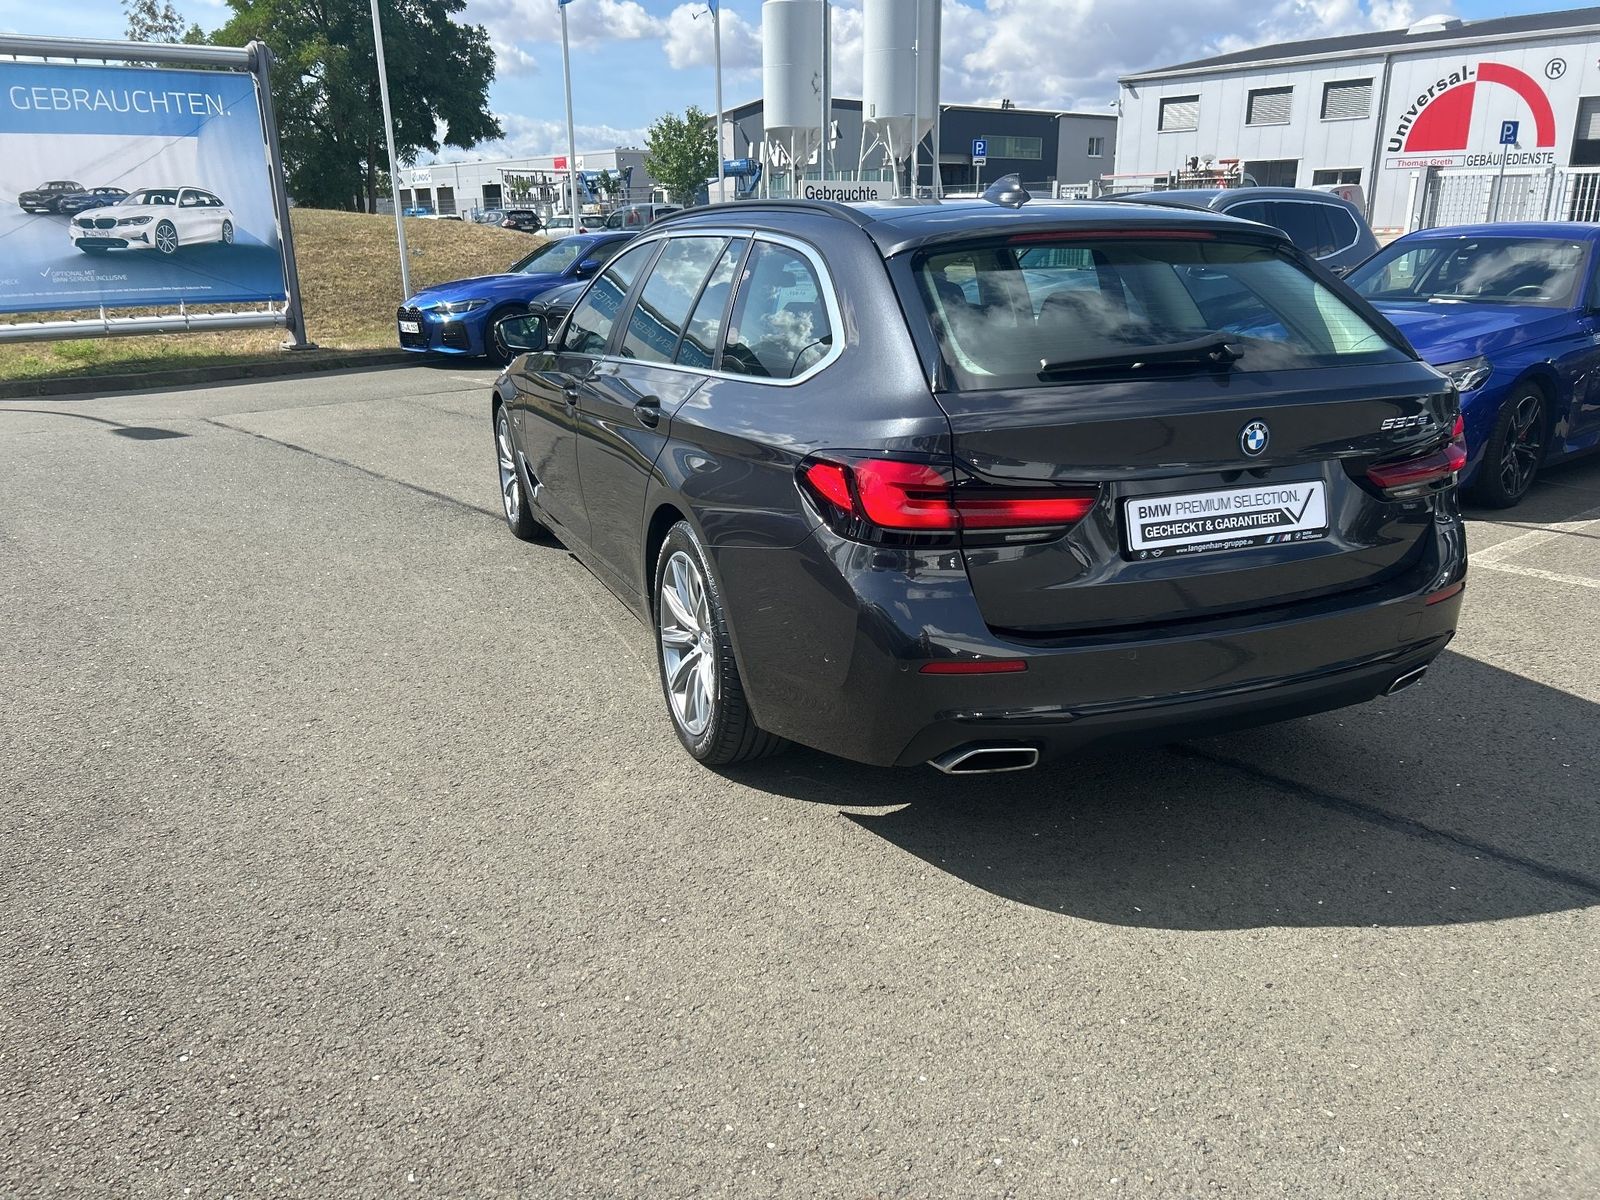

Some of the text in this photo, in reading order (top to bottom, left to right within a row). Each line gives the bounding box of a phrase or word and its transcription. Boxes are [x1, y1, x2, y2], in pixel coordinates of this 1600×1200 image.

[9, 86, 231, 116] GEBRAUCHTEN.
[1387, 65, 1475, 153] Universal-
[1502, 123, 1514, 141] P
[976, 142, 984, 155] P
[1397, 158, 1453, 167] Thomas Greth
[1466, 152, 1554, 167] GEBÄUEDIENSTE
[805, 185, 878, 201] Gebrauchte
[1138, 489, 1301, 520] BMW PREMIUM SELECTION.
[1144, 511, 1281, 539] GECHECKT & GARANTIERT
[1175, 539, 1254, 554] www.langenhan-gruppe.de
